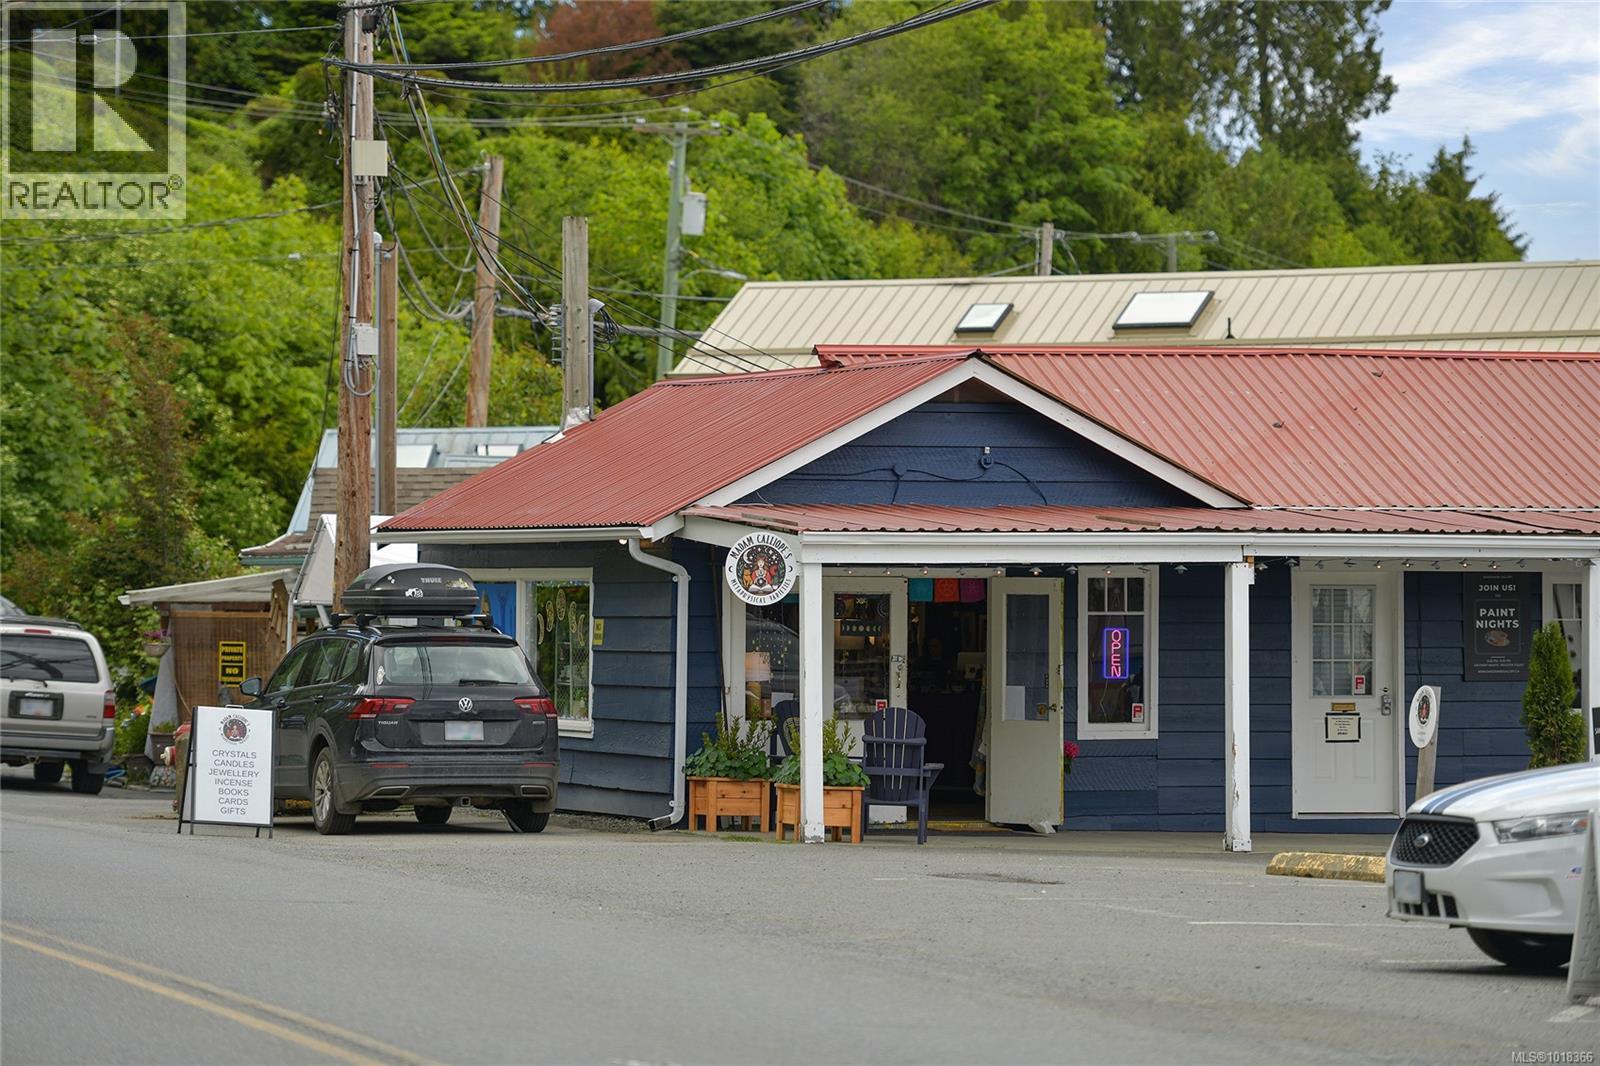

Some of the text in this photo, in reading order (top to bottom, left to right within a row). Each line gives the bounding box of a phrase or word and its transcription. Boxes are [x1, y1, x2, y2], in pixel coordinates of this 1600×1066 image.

[730, 534, 792, 560] MADAM CALLIOPE'S
[1479, 608, 1515, 617] PAINT
[1475, 620, 1520, 629] NIGHTS
[1111, 629, 1121, 677] OPEN
[212, 749, 257, 759] CRYSTALS
[213, 759, 255, 768] CANDLES
[208, 768, 260, 778] JEWELLERY
[214, 778, 253, 787] INCENSE
[218, 787, 249, 797] BOOKS
[218, 797, 249, 806] CARDS
[220, 806, 247, 815] GIFTS
